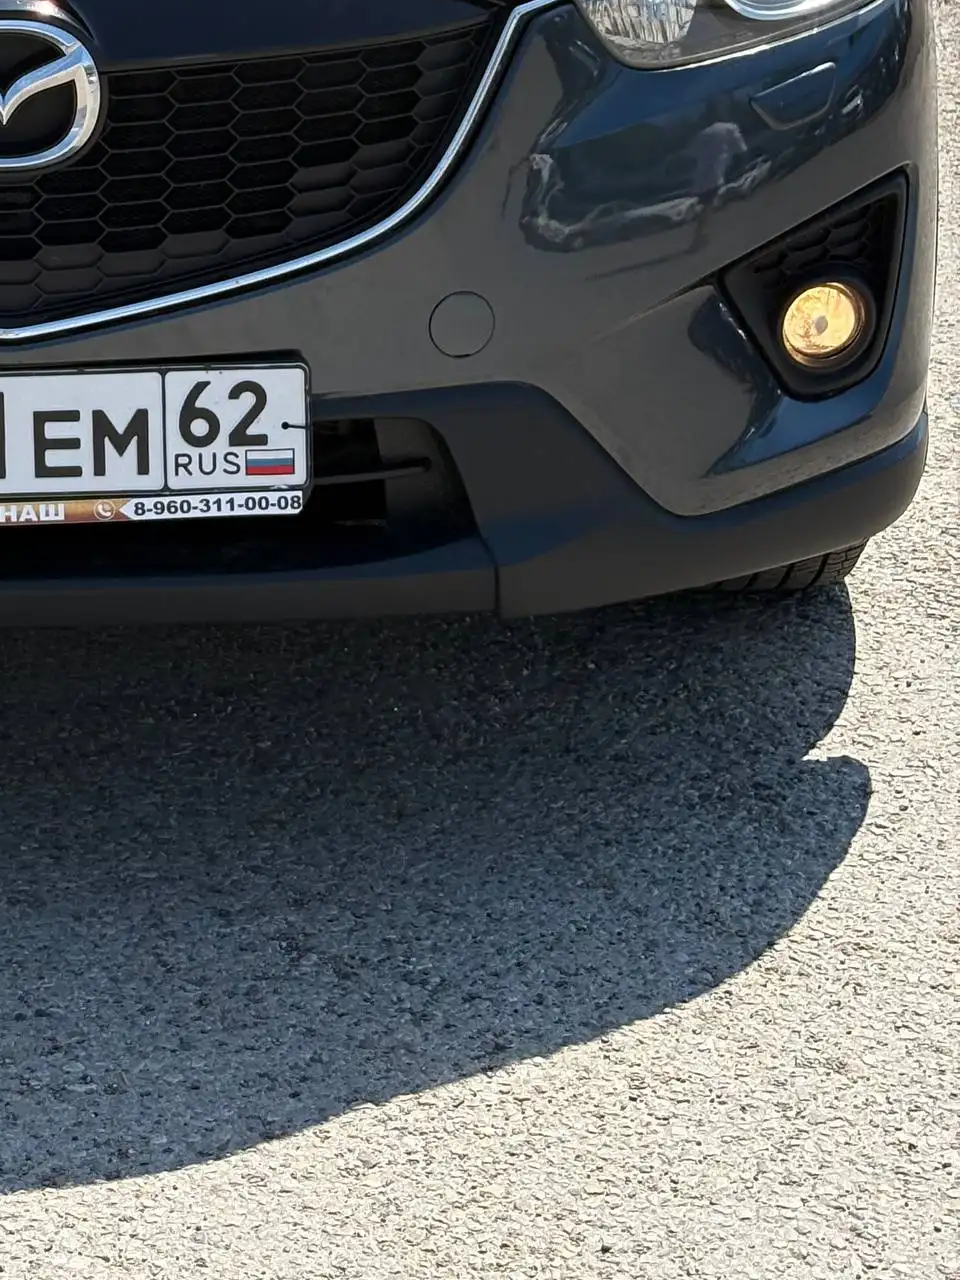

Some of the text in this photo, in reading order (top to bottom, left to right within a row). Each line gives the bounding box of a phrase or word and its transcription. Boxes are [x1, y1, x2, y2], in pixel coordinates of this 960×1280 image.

[178, 380, 269, 448] 62
[174, 451, 241, 477] RUS
[133, 494, 302, 517] 8-960-311-00-08
